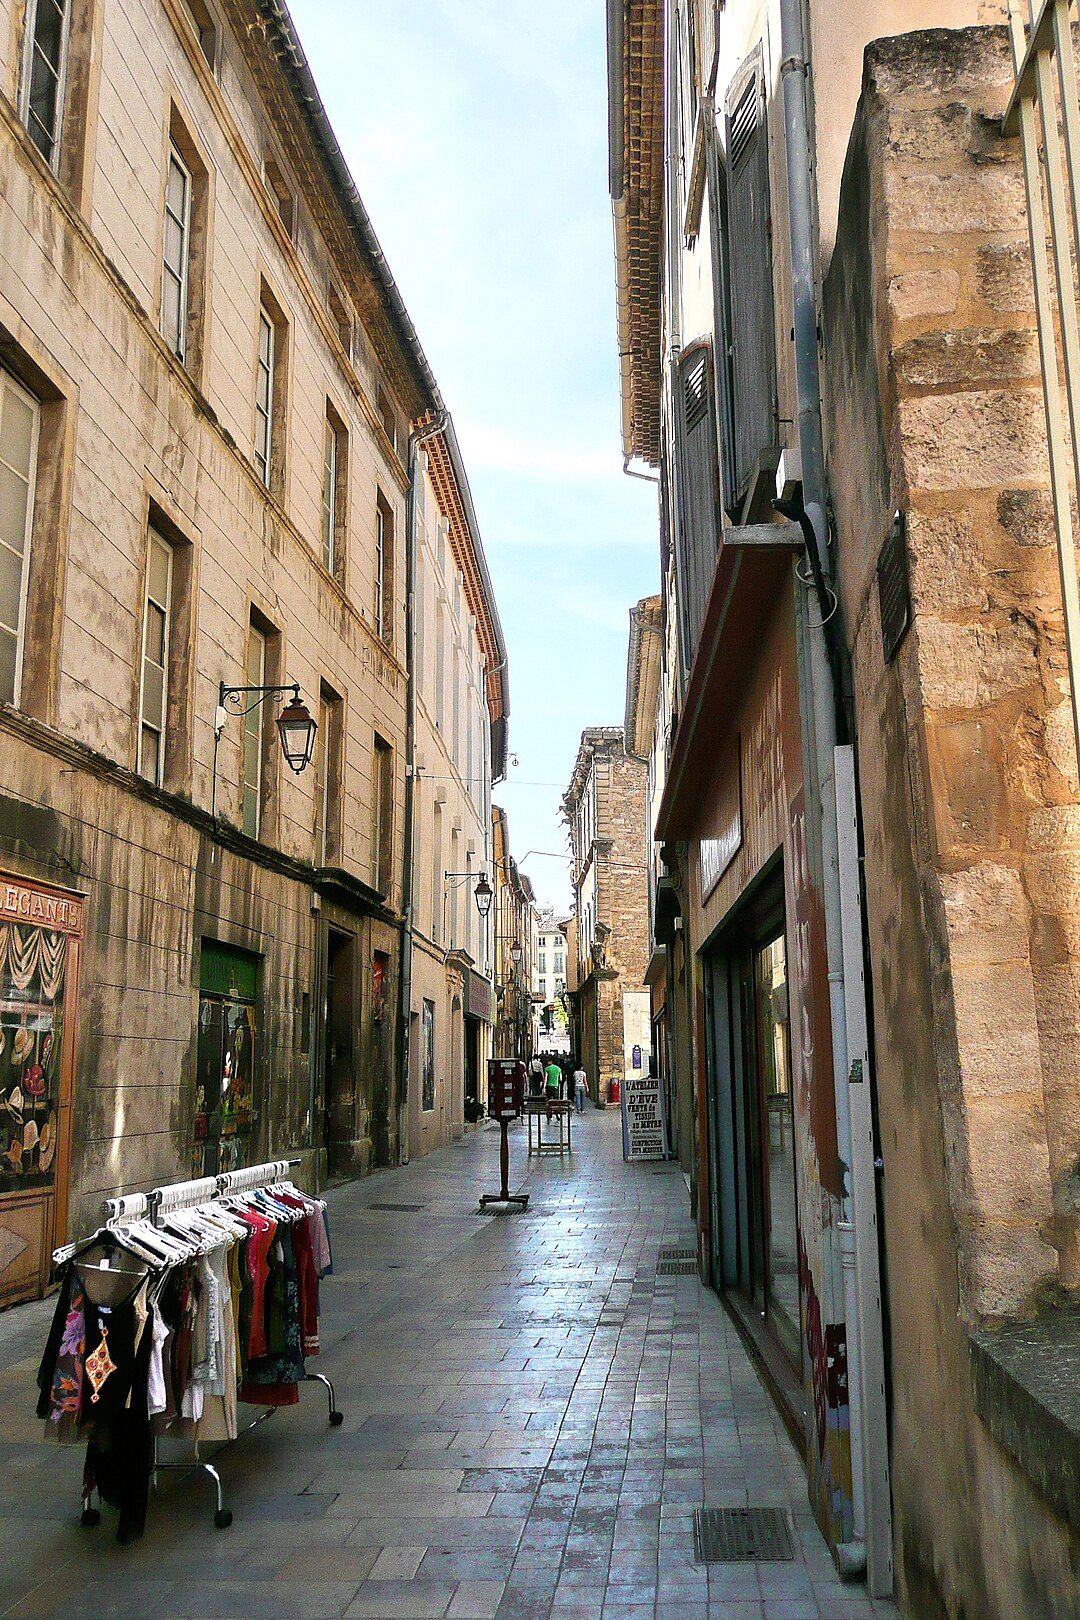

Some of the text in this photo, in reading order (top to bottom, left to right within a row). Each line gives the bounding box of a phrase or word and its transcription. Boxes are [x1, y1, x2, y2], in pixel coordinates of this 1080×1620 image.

[0, 888, 77, 926] EGANTS
[626, 1080, 658, 1090] L'ATELIER
[635, 1112, 655, 1120] TISSUS
